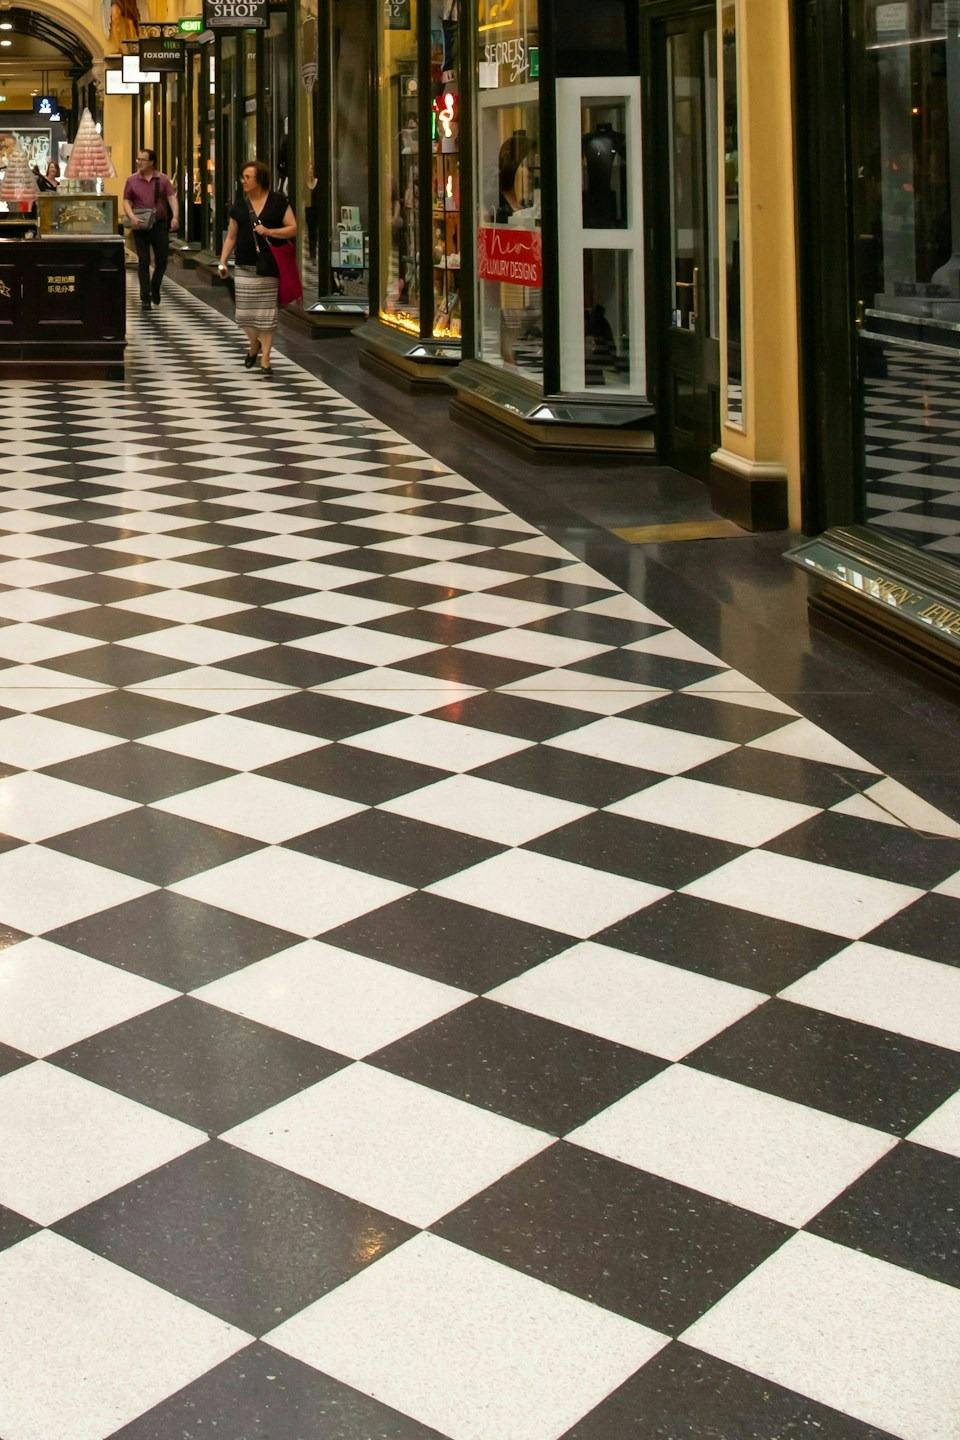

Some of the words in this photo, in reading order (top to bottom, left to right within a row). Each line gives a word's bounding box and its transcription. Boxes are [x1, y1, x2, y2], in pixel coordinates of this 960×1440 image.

[214, 4, 258, 17] SHOP
[143, 51, 181, 59] roxanne
[484, 38, 525, 65] SECRETS
[487, 259, 510, 276] LUXURY
[510, 261, 537, 281] DESIGNS
